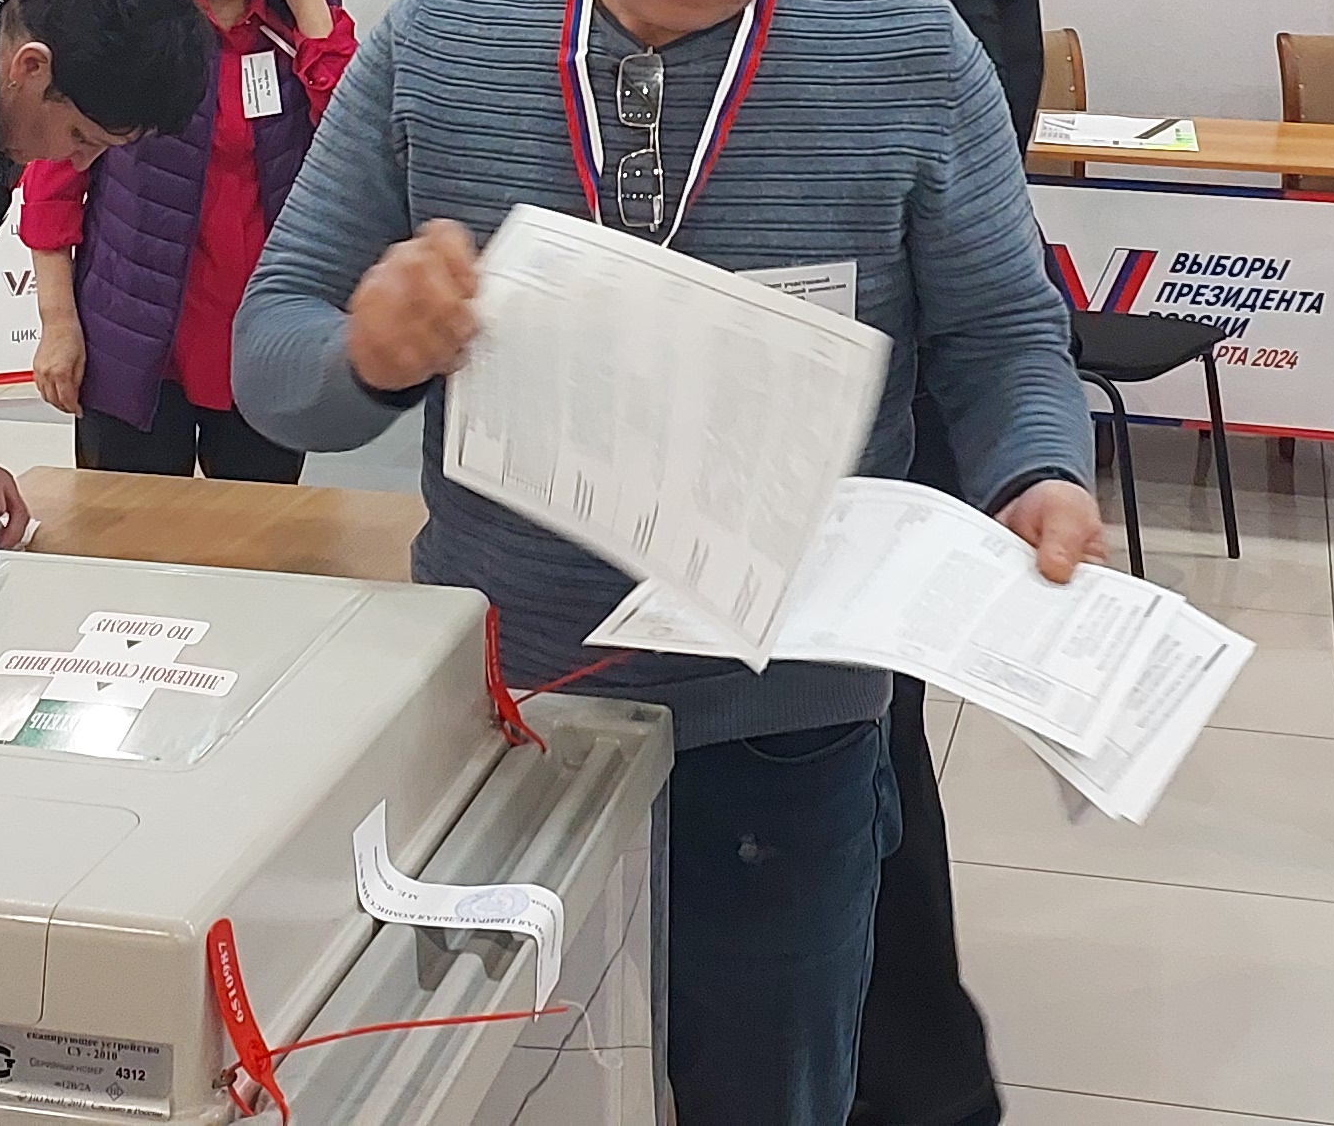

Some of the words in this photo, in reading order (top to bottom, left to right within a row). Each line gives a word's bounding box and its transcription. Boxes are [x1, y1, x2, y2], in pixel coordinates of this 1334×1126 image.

[1169, 252, 1292, 282] ВЫБОРЫ
[1155, 282, 1325, 314] ПРЕЗИДЕНТА
[11, 329, 41, 344] ЦИК.
[1205, 346, 1249, 367] РТА
[1251, 348, 1299, 370] 2024
[91, 618, 164, 637] ОДНОМУ
[166, 625, 195, 641] ПО
[5, 655, 52, 672] ВНИЗ
[49, 656, 140, 680] СТОРОНОЙ
[139, 665, 225, 691] ЛИЦЕВОЙ
[217, 942, 245, 1024] 6510987
[115, 1067, 146, 1082] 4312
